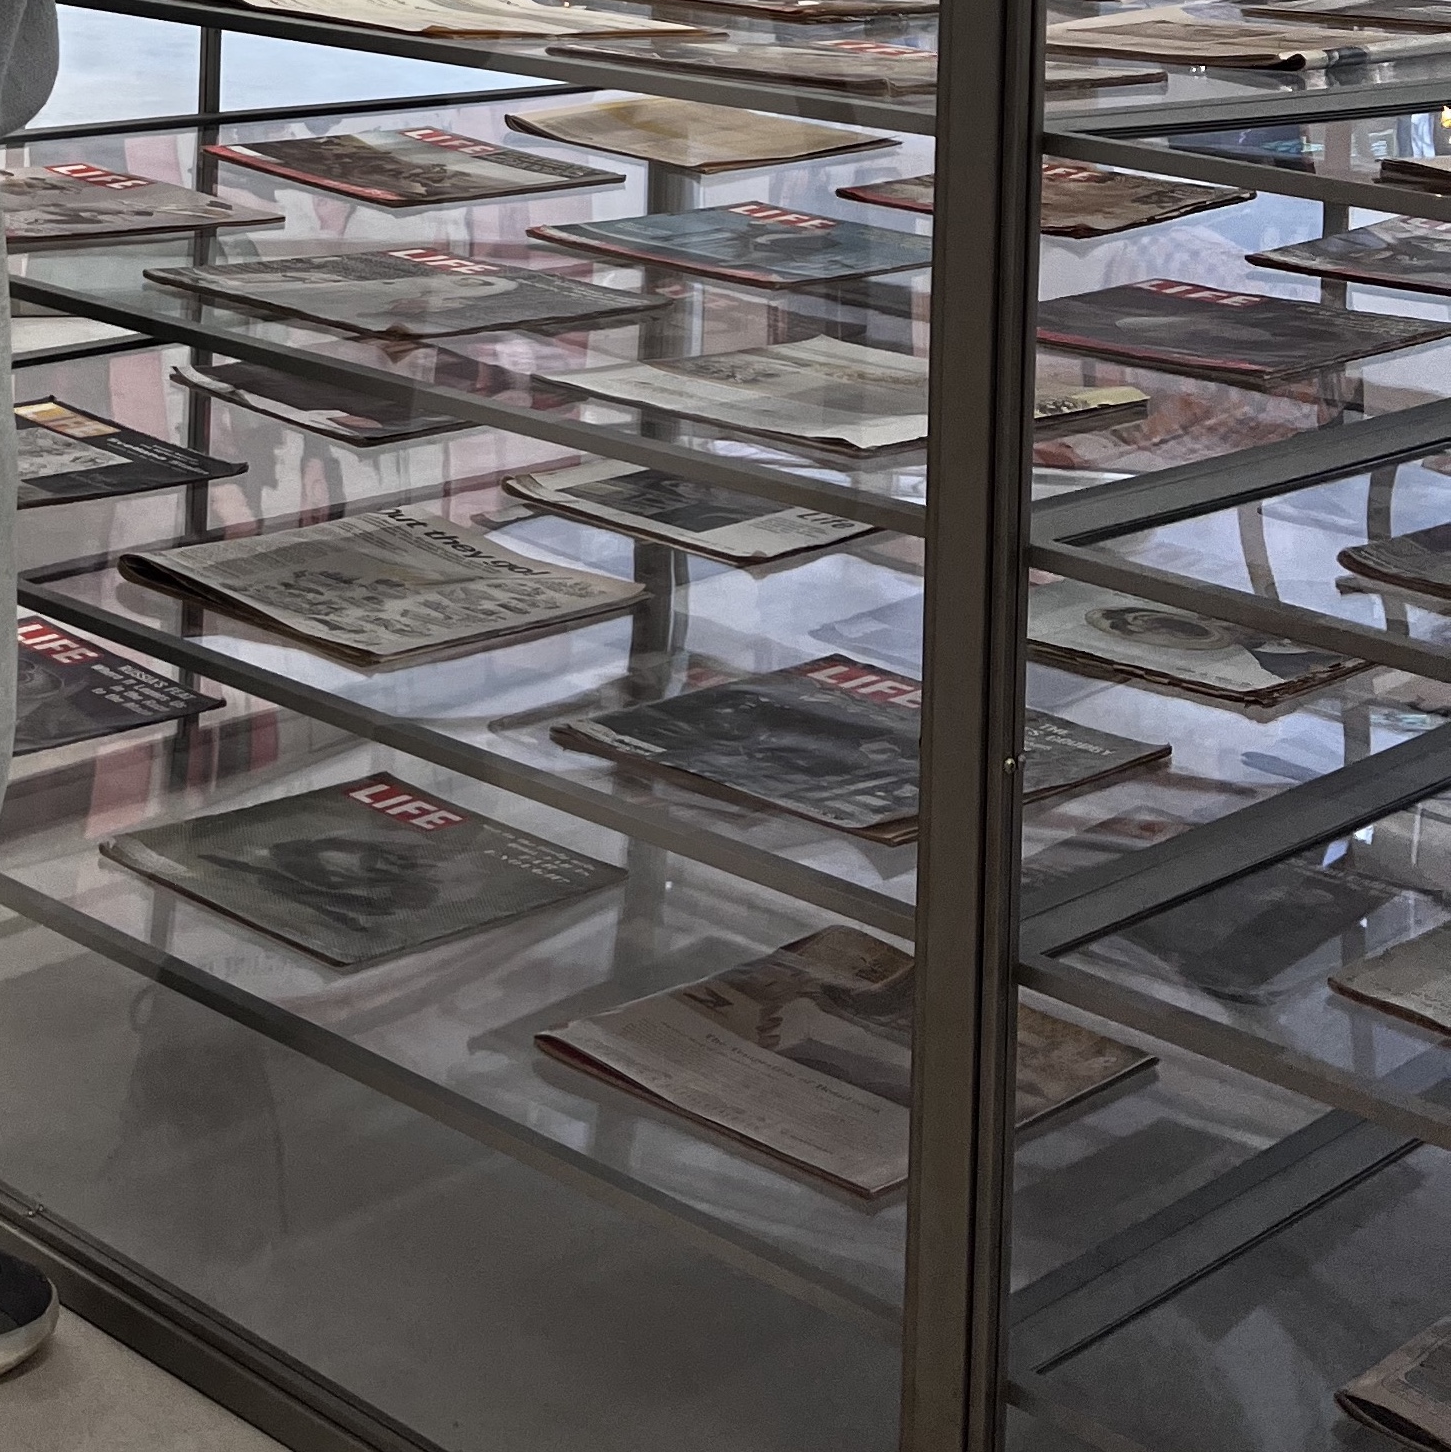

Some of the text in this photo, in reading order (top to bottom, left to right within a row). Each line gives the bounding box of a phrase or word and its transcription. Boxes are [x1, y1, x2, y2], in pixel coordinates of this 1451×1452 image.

[403, 129, 496, 154] LIFE
[51, 164, 148, 189] LIFE
[728, 205, 837, 228] LIFE
[388, 249, 500, 274] LIFE
[1133, 280, 1261, 306] LIFE
[17, 623, 99, 664] LIFE
[349, 783, 464, 830] LIFE
